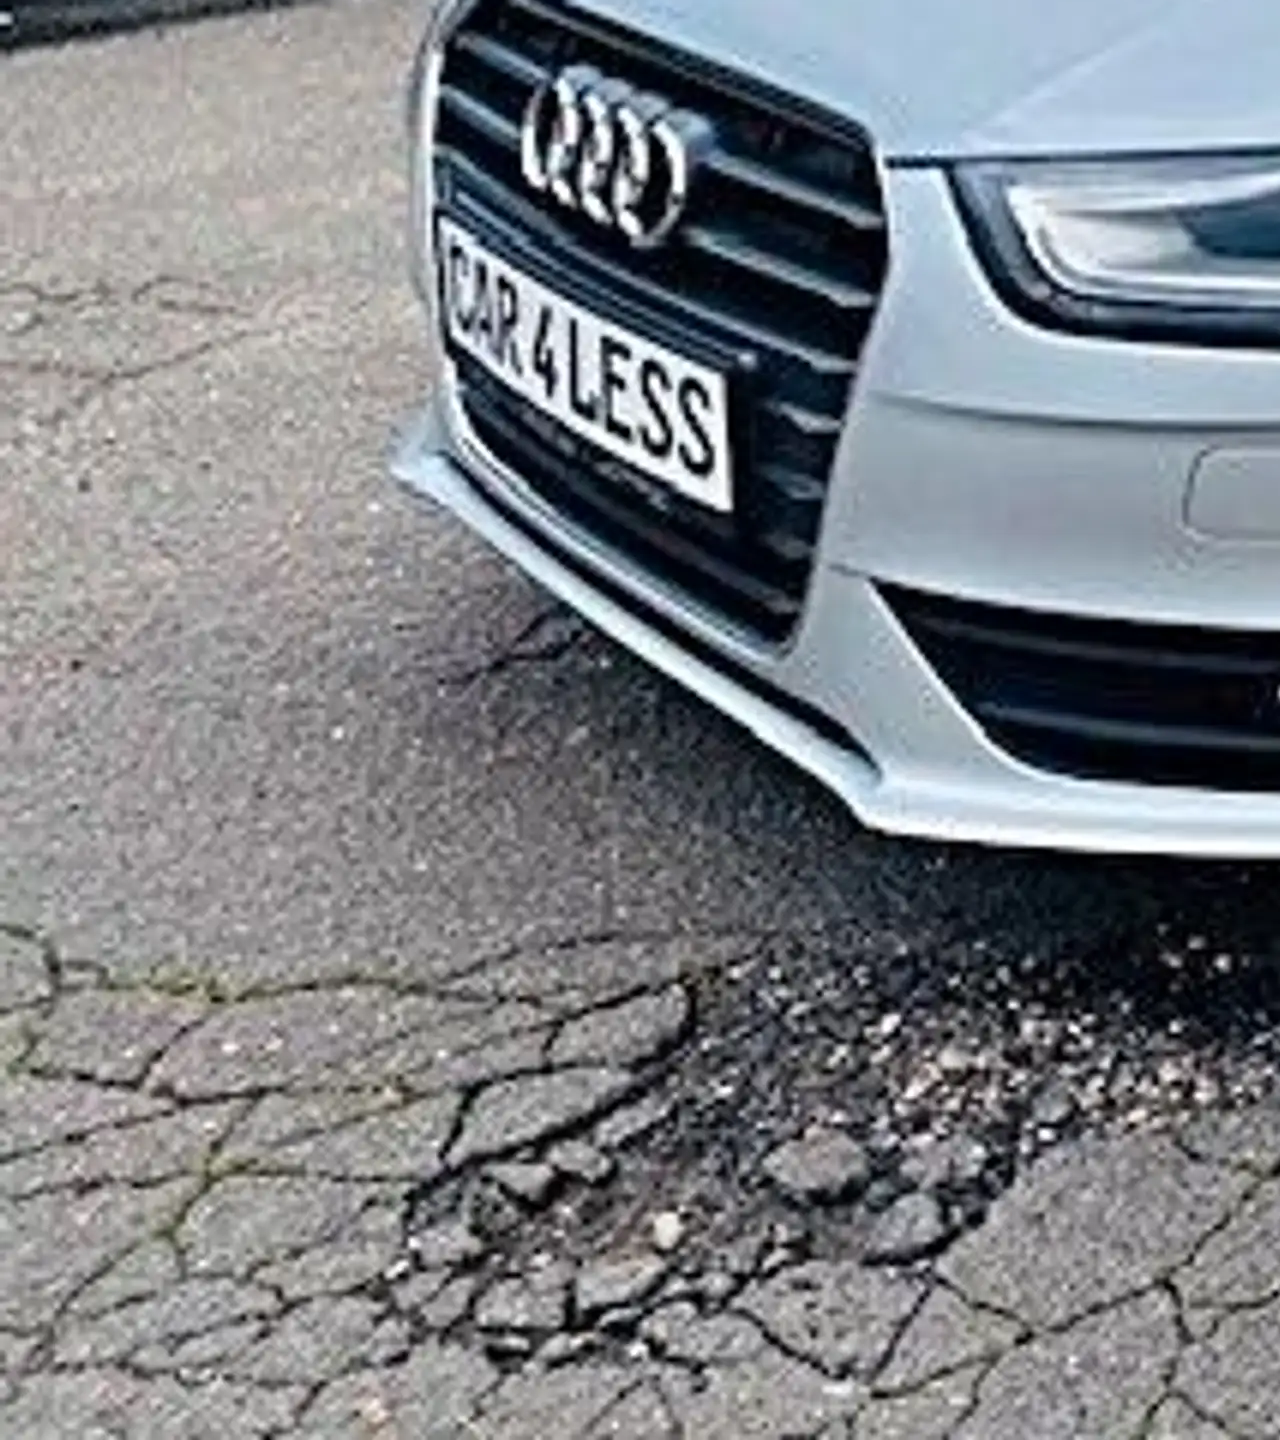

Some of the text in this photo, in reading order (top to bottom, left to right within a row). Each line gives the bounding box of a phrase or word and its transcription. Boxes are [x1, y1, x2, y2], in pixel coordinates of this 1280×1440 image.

[449, 243, 717, 478] CAR 4 LESS
